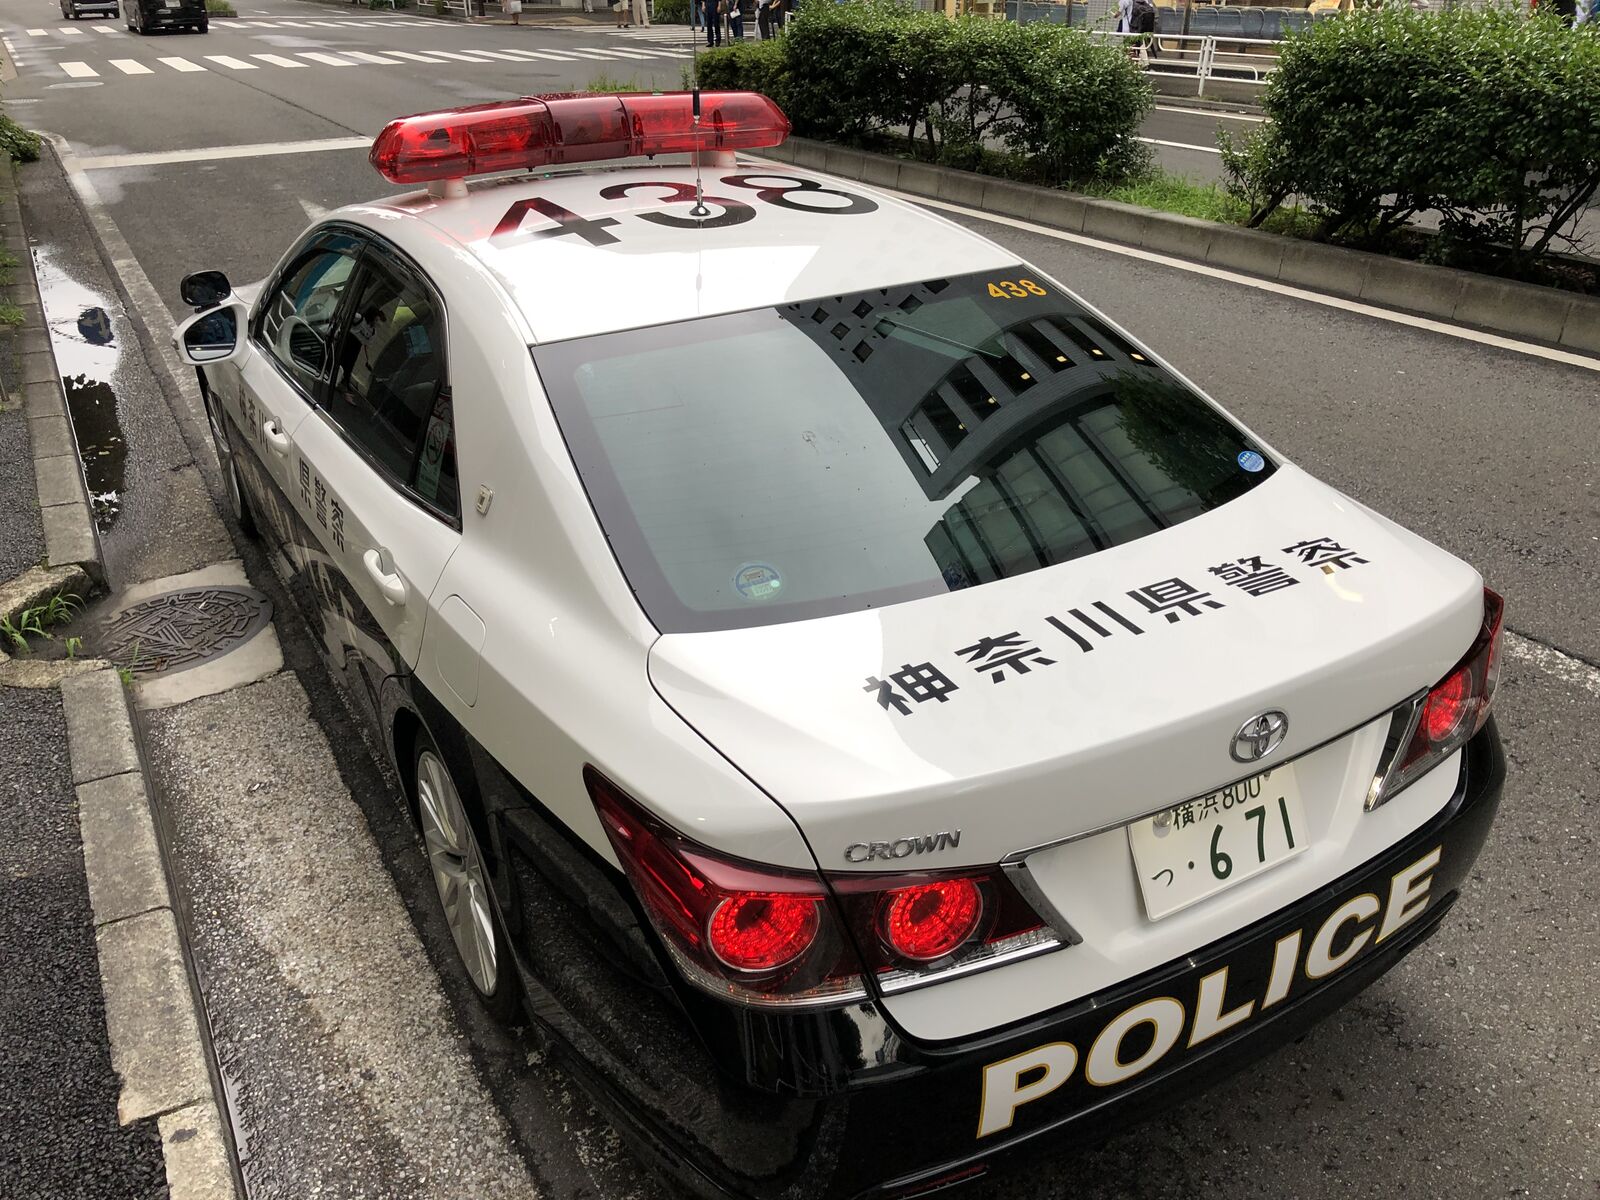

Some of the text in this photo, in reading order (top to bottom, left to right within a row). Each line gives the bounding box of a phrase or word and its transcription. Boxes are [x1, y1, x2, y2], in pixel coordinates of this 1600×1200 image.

[488, 174, 880, 248] 438
[987, 279, 1047, 299] 438
[862, 536, 1371, 717] 神奈川県警察
[844, 828, 961, 863] CROWN
[976, 845, 1443, 1140] POLICE
